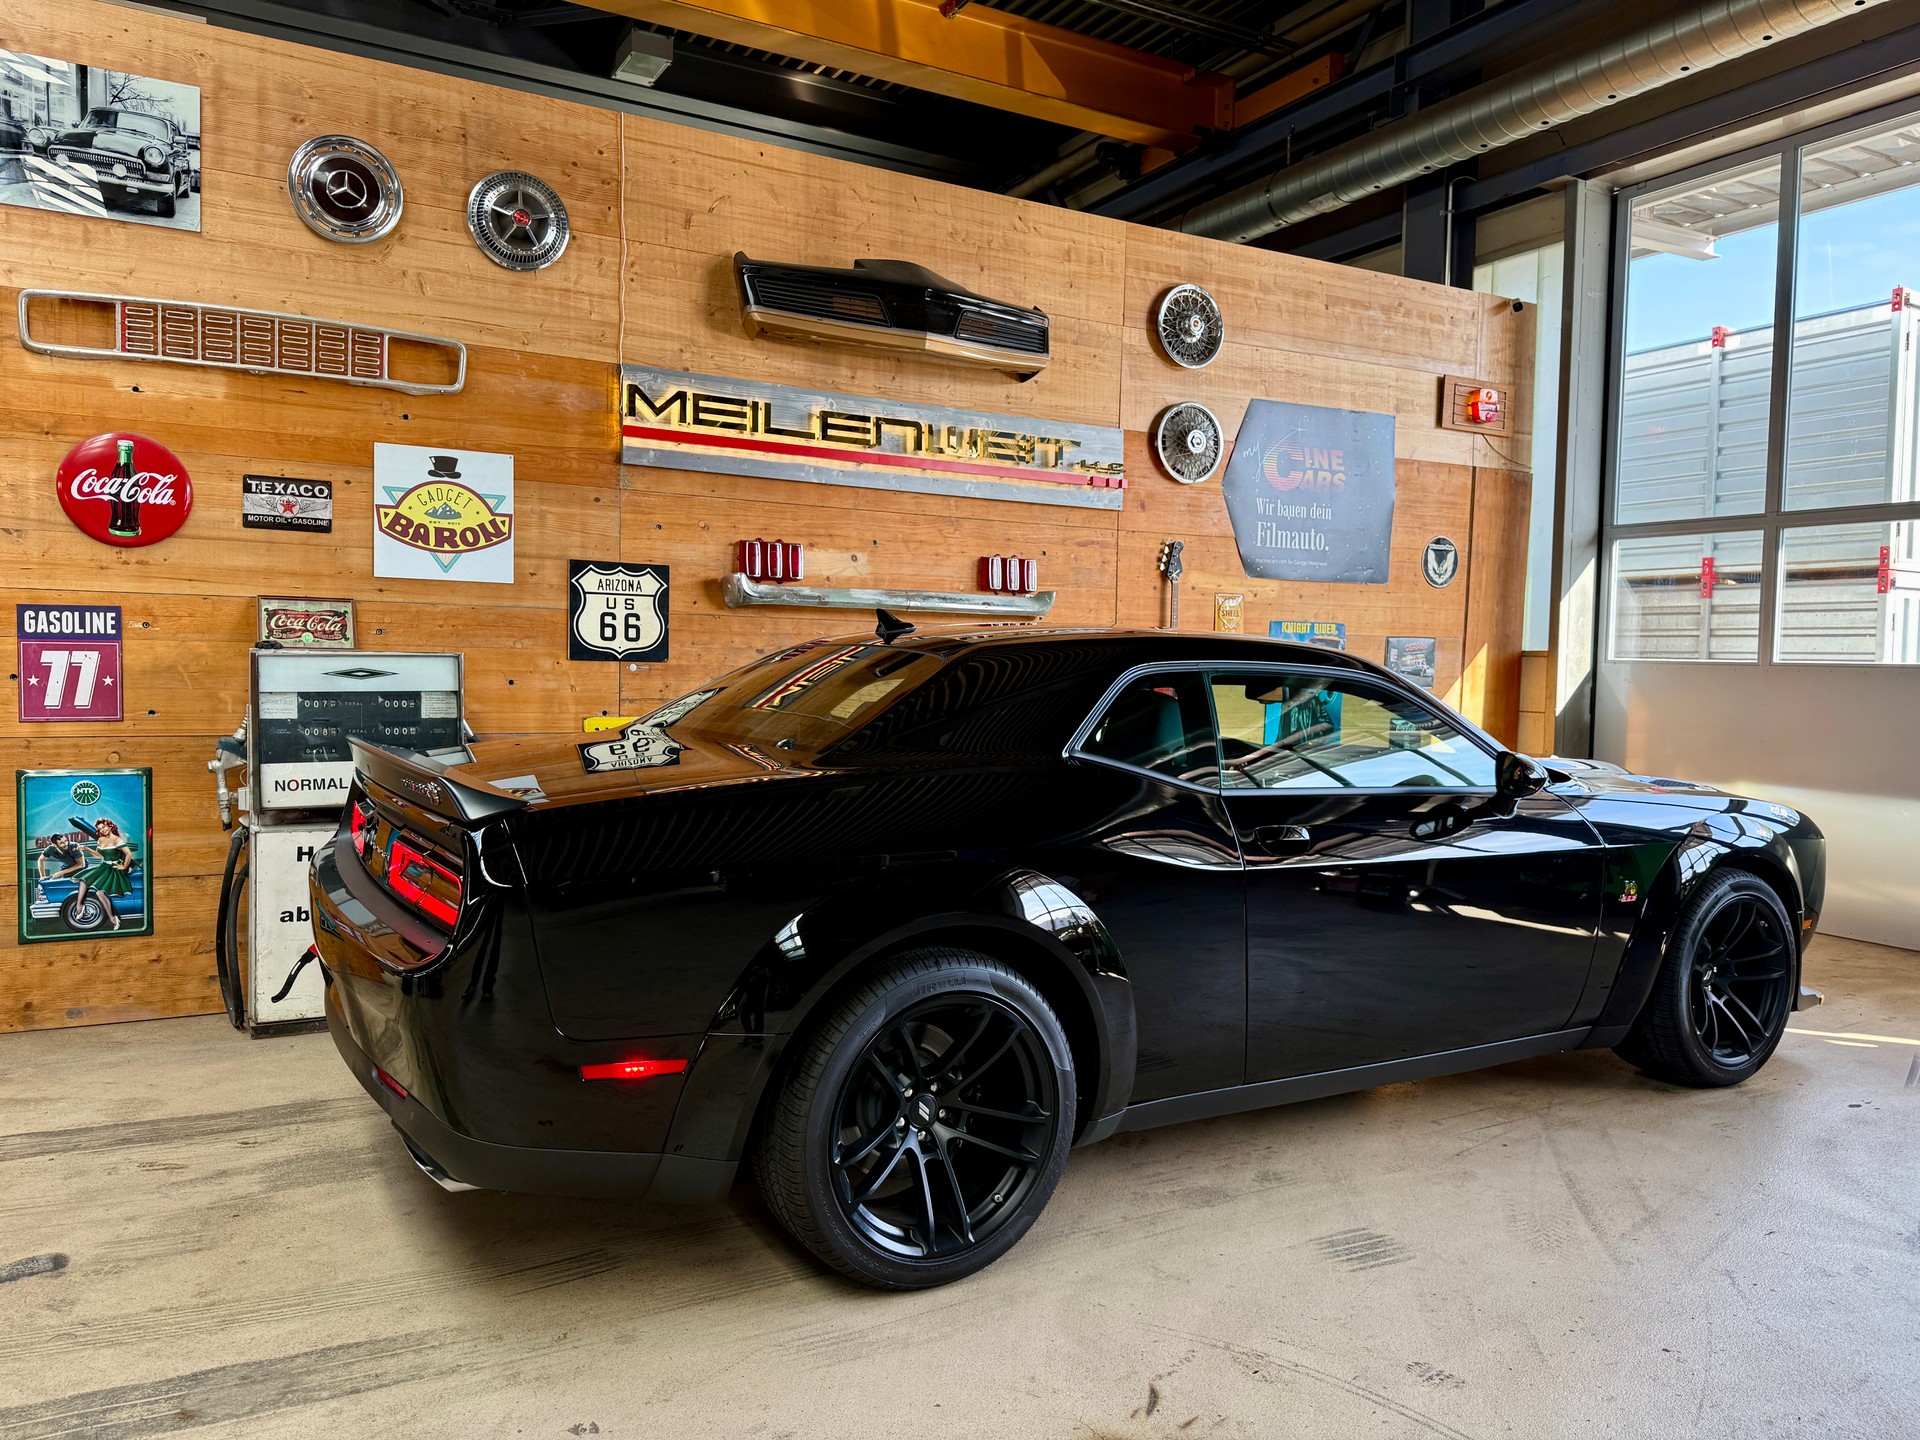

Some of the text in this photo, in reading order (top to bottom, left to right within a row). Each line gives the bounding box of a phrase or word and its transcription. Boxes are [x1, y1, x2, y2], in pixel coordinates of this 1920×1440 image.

[70, 468, 178, 505] Coca-Cola
[247, 479, 329, 498] TEXACO
[416, 487, 474, 509] GADGET
[1256, 497, 1332, 520] Wir bauen dein
[248, 515, 274, 523] MOTOR
[292, 518, 329, 527] GASOLINE
[385, 510, 507, 549] BARON
[1256, 521, 1329, 551] Filmauto.
[597, 578, 643, 592] ARIZONA
[23, 610, 117, 634] GASOLINE
[270, 613, 344, 631] Coca-Cola
[1221, 609, 1240, 618] SHELL
[600, 611, 641, 642] 66
[1281, 622, 1311, 634] KNIGHT
[274, 777, 349, 792] NORMAL
